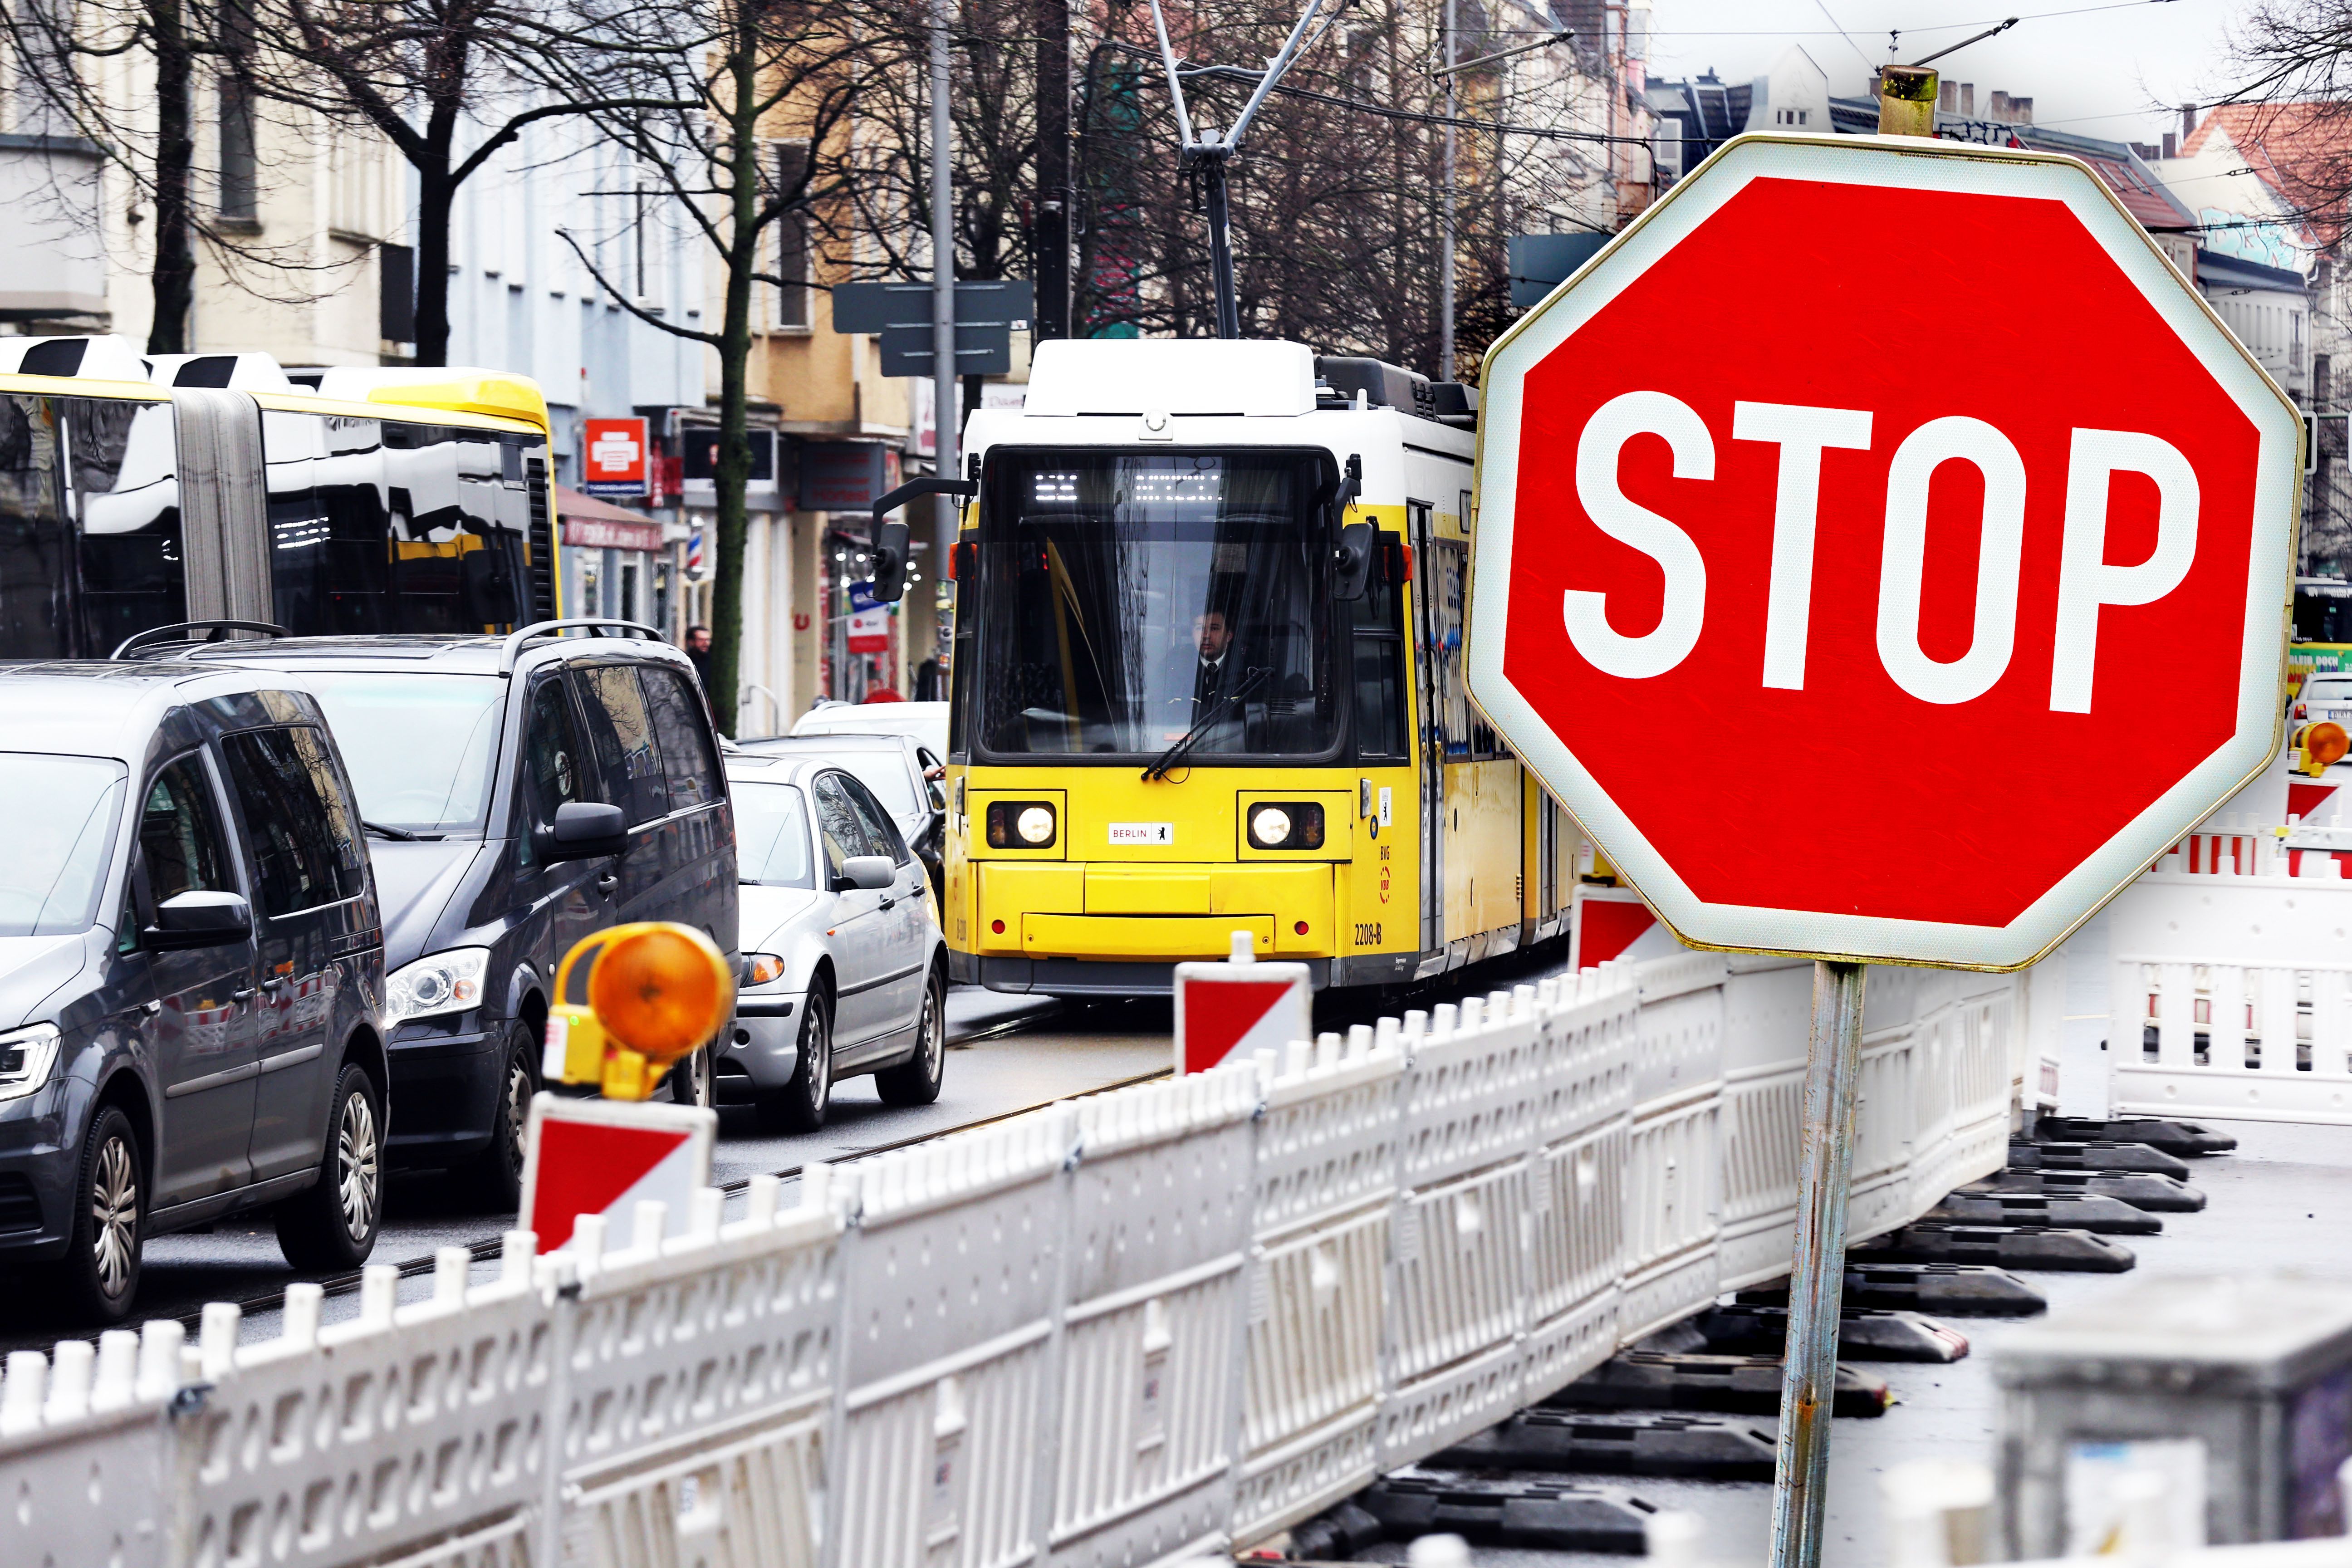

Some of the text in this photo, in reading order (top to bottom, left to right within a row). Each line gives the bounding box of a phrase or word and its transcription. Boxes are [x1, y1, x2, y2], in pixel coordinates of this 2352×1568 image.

[1563, 390, 2200, 714] STOP
[1113, 829, 1147, 838] BERLIN
[1380, 845, 1390, 860] BVG
[1381, 879, 1389, 891] VBB
[1355, 922, 1382, 946] 2208-B
